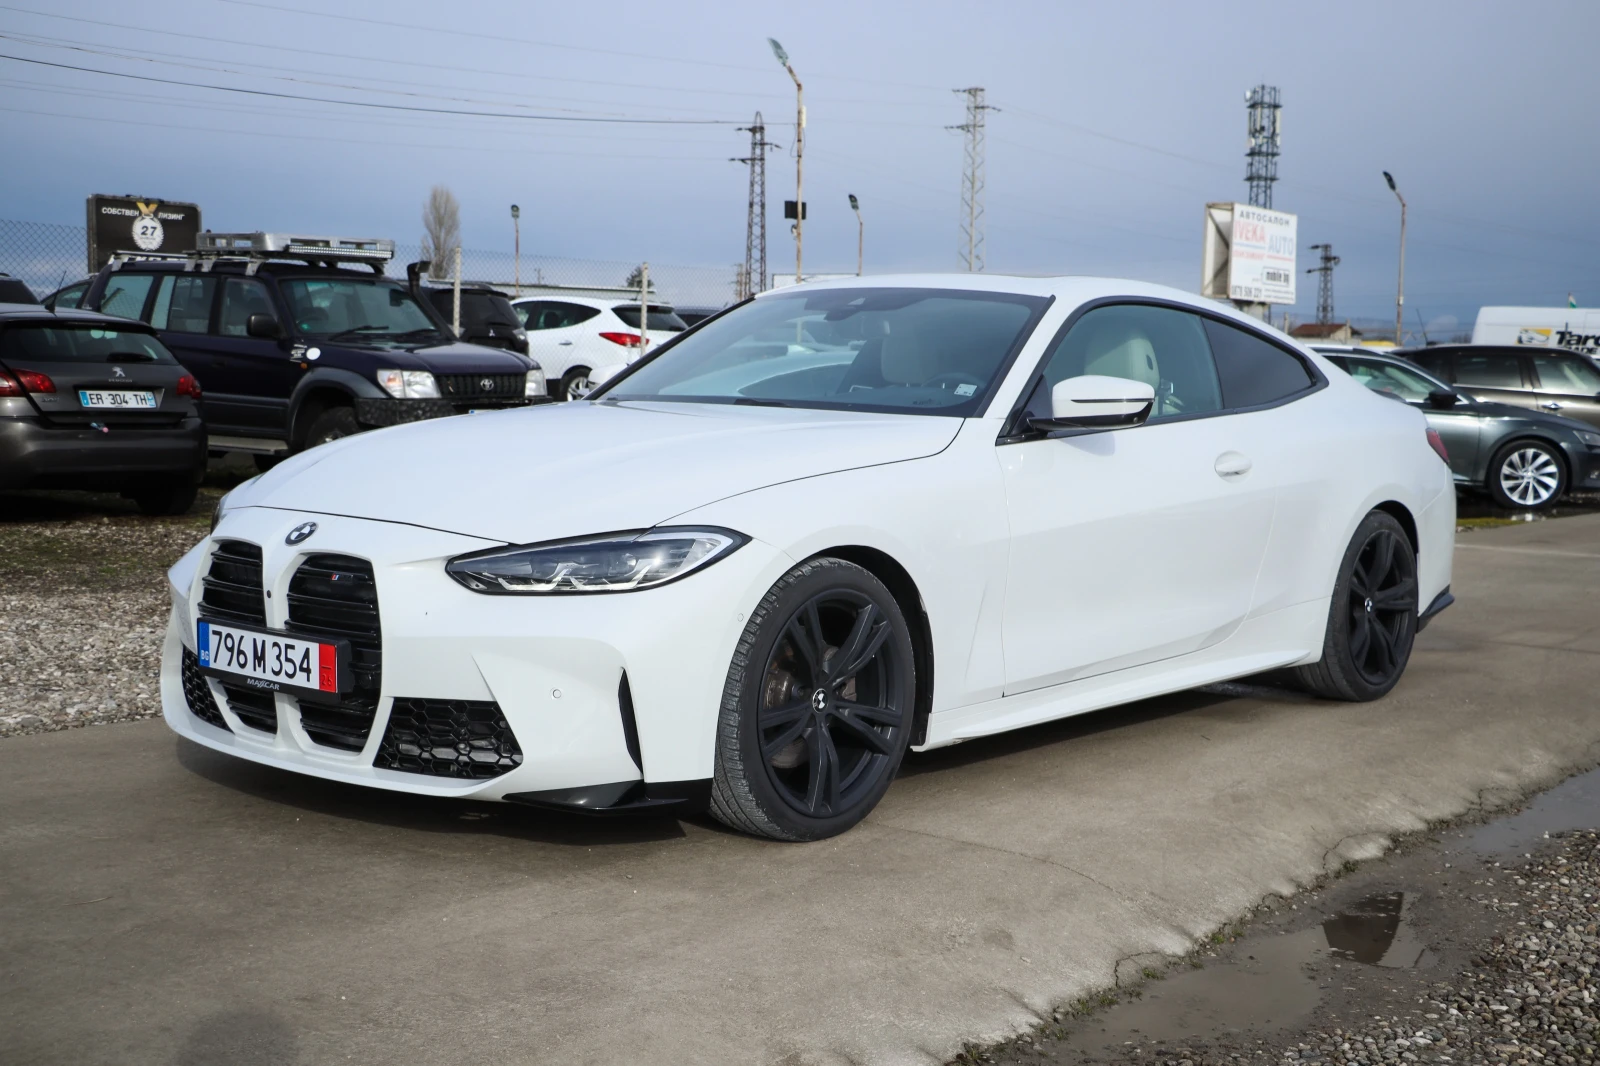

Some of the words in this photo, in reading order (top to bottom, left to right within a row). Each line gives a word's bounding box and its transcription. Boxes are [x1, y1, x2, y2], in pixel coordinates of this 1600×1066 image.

[101, 206, 139, 217] СОБСТВЕН
[158, 212, 185, 220] ЛИЗИНГ
[1240, 210, 1290, 226] АВТОСАЛОН
[140, 225, 157, 236] 27
[1268, 234, 1294, 255] AUTO
[200, 650, 210, 660] BG
[211, 630, 248, 669] 796
[252, 637, 267, 674] M
[271, 641, 312, 682] 354
